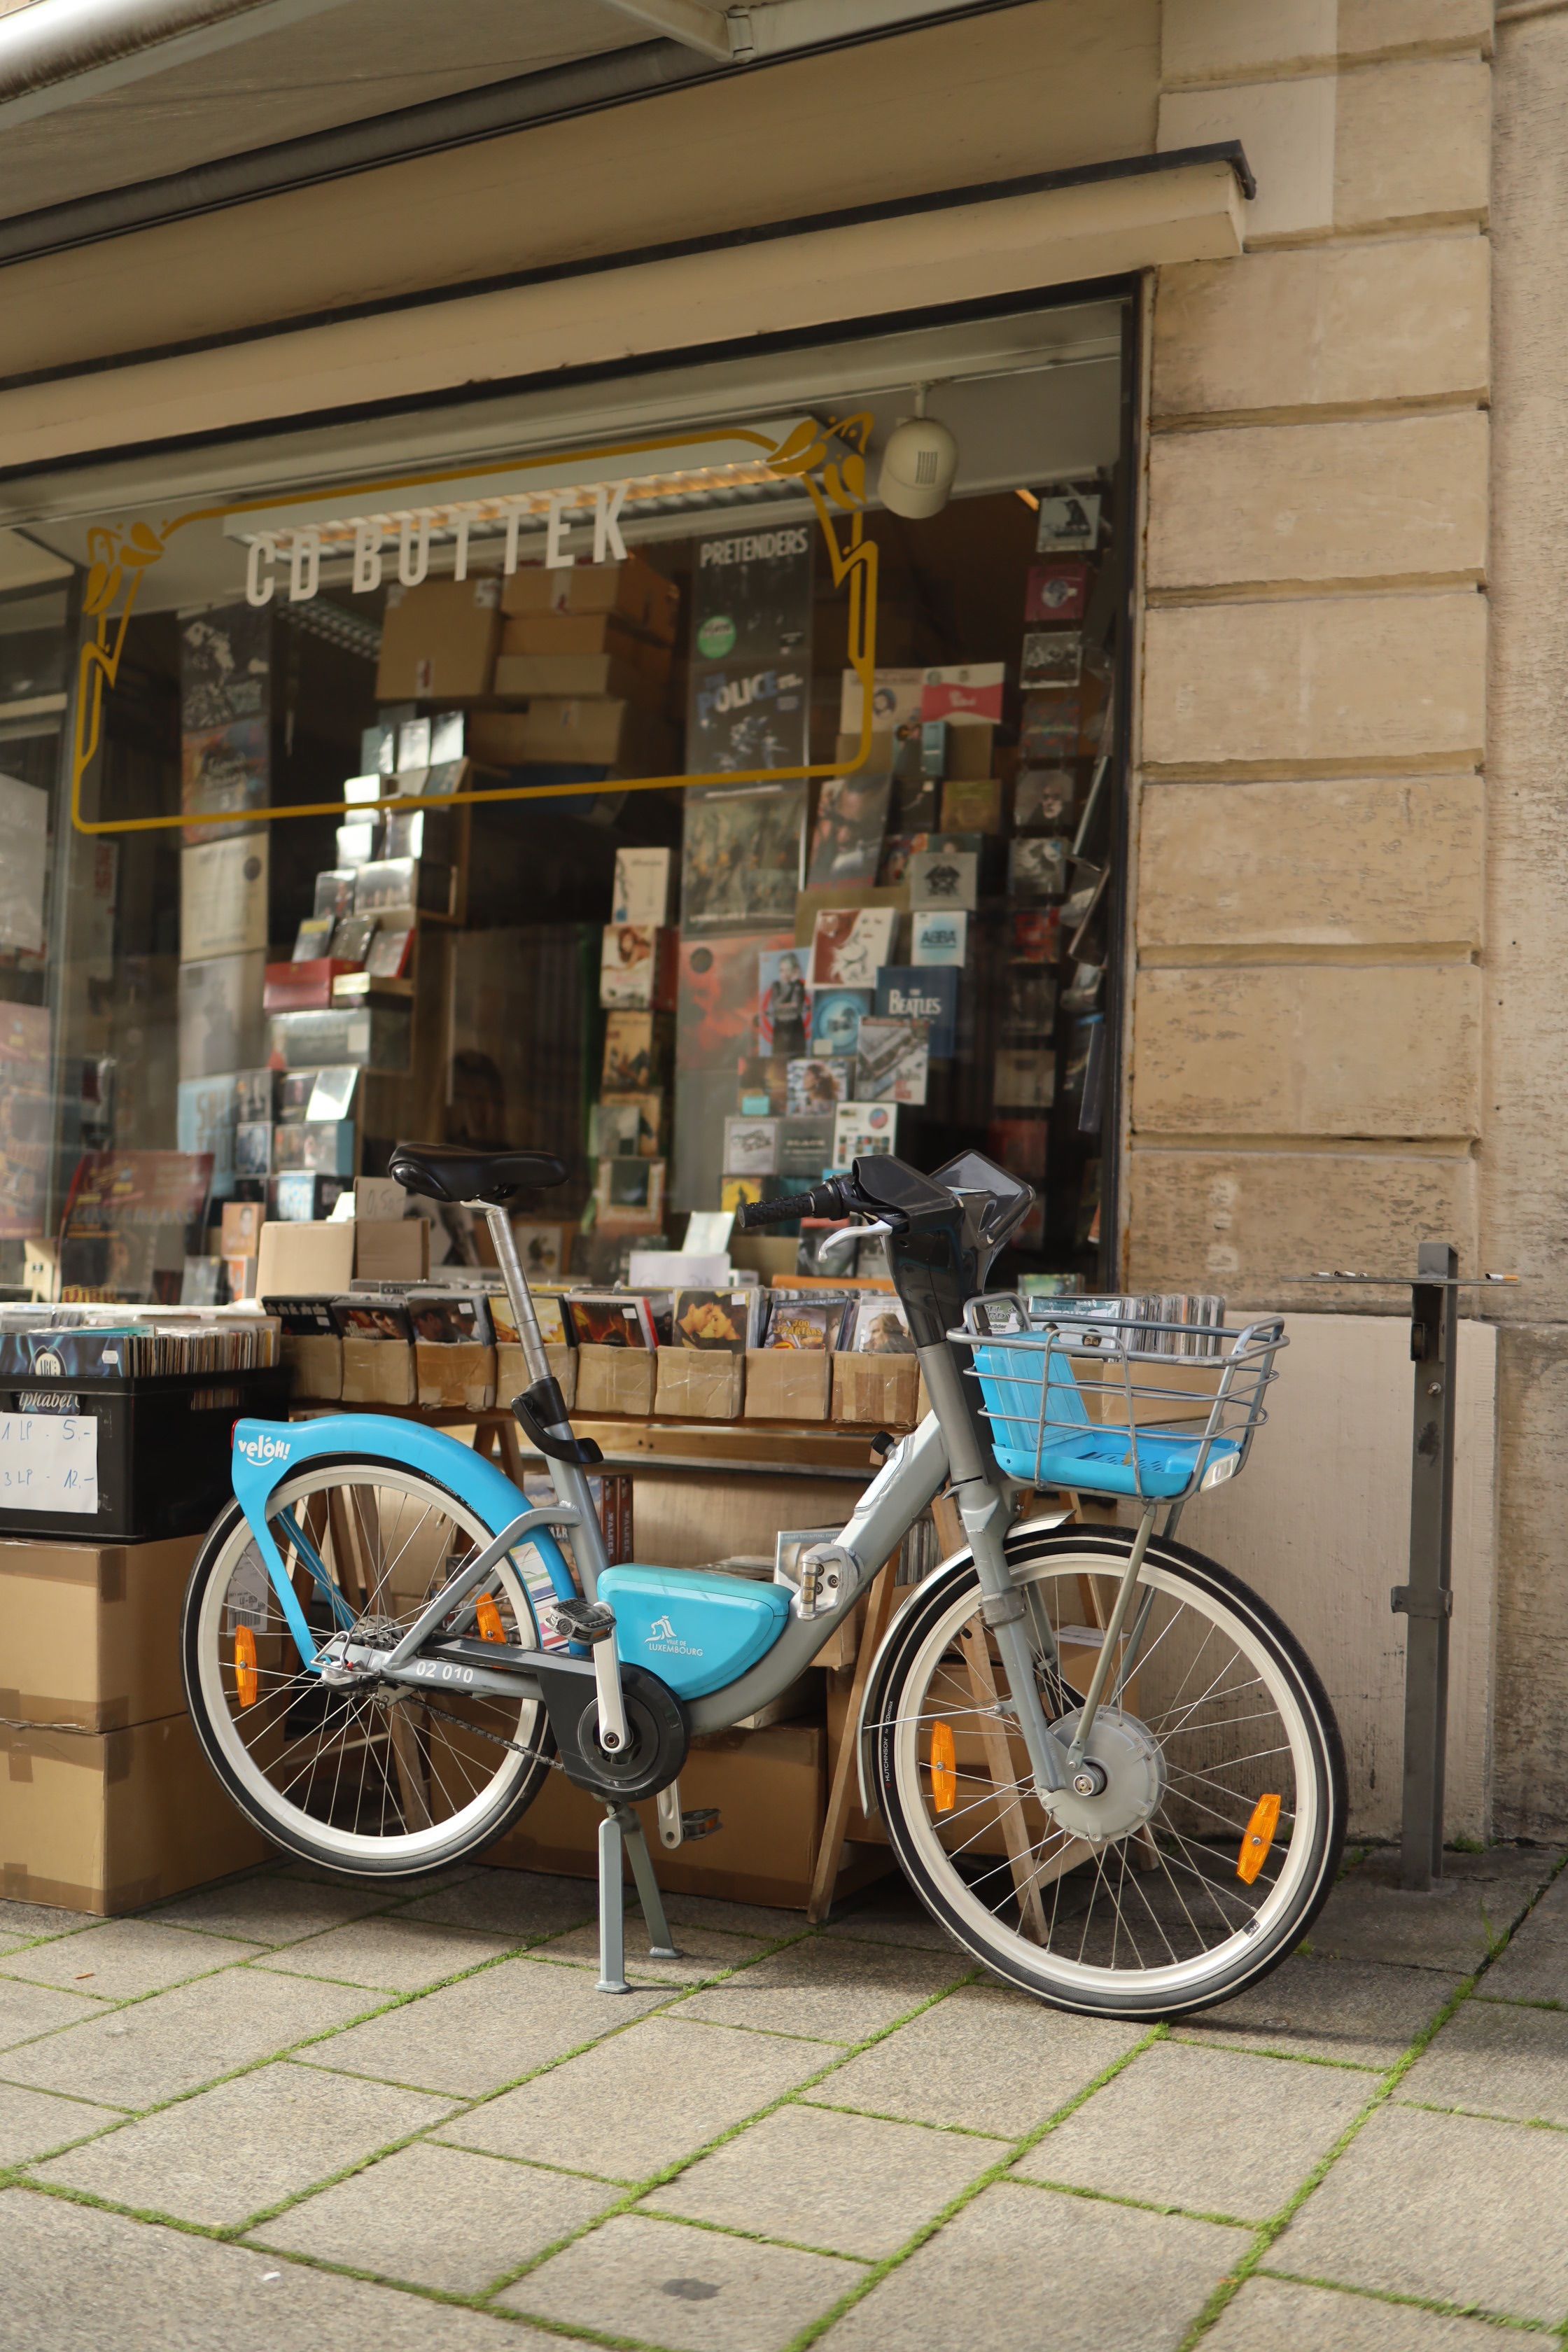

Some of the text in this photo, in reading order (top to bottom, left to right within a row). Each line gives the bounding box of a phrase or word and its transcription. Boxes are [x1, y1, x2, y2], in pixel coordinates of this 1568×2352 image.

[246, 484, 630, 607] CD BUTTEK
[700, 528, 808, 568] PRETENDERS
[697, 671, 777, 720] POLICE
[920, 930, 957, 944] ABBA
[889, 989, 942, 1018] BEATLES
[773, 1325, 822, 1336] SPARTANS
[1, 1421, 10, 1441] 1
[20, 1421, 32, 1441] LP
[4, 1471, 11, 1487] 3
[18, 1469, 33, 1486] LP
[649, 1643, 704, 1657] LUXEMBOURG
[416, 1660, 475, 1684] 02 010
